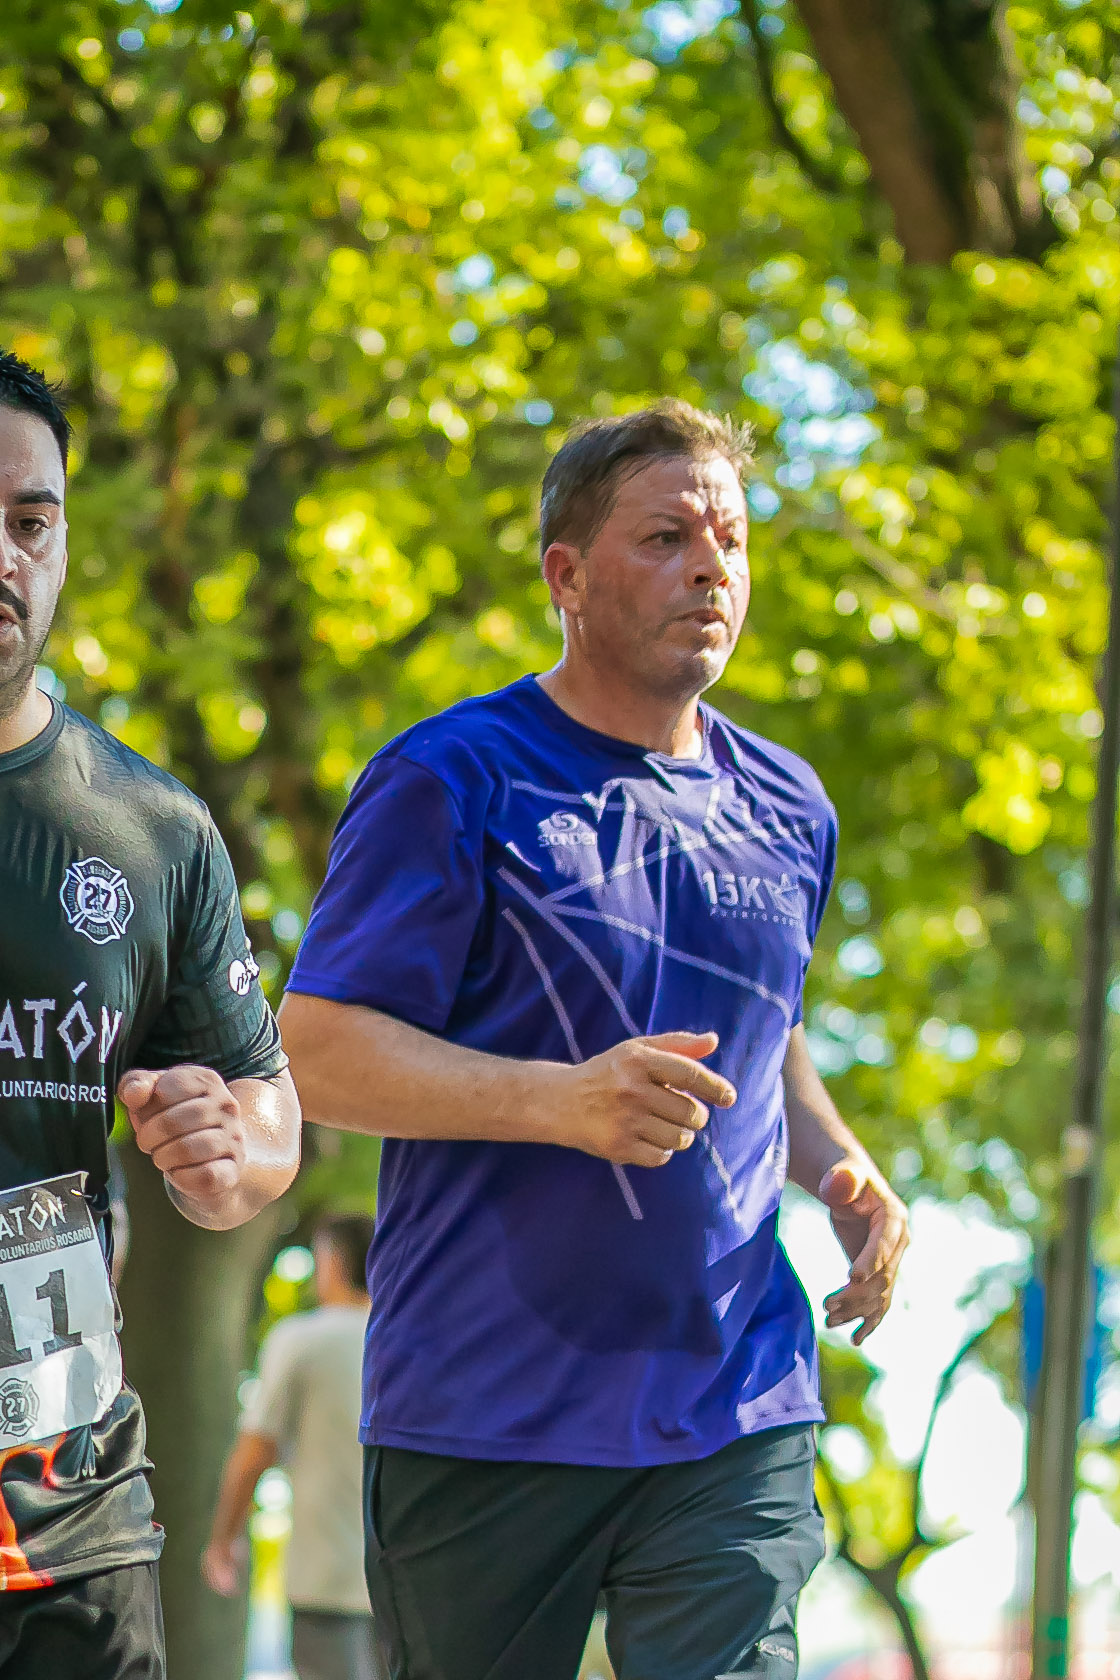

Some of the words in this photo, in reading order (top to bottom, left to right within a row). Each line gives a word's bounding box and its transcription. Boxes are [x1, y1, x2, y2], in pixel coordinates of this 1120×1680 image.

[84, 881, 112, 910] 27
[56, 1227, 92, 1248] ROSARIO
[4, 1397, 27, 1418] 27
